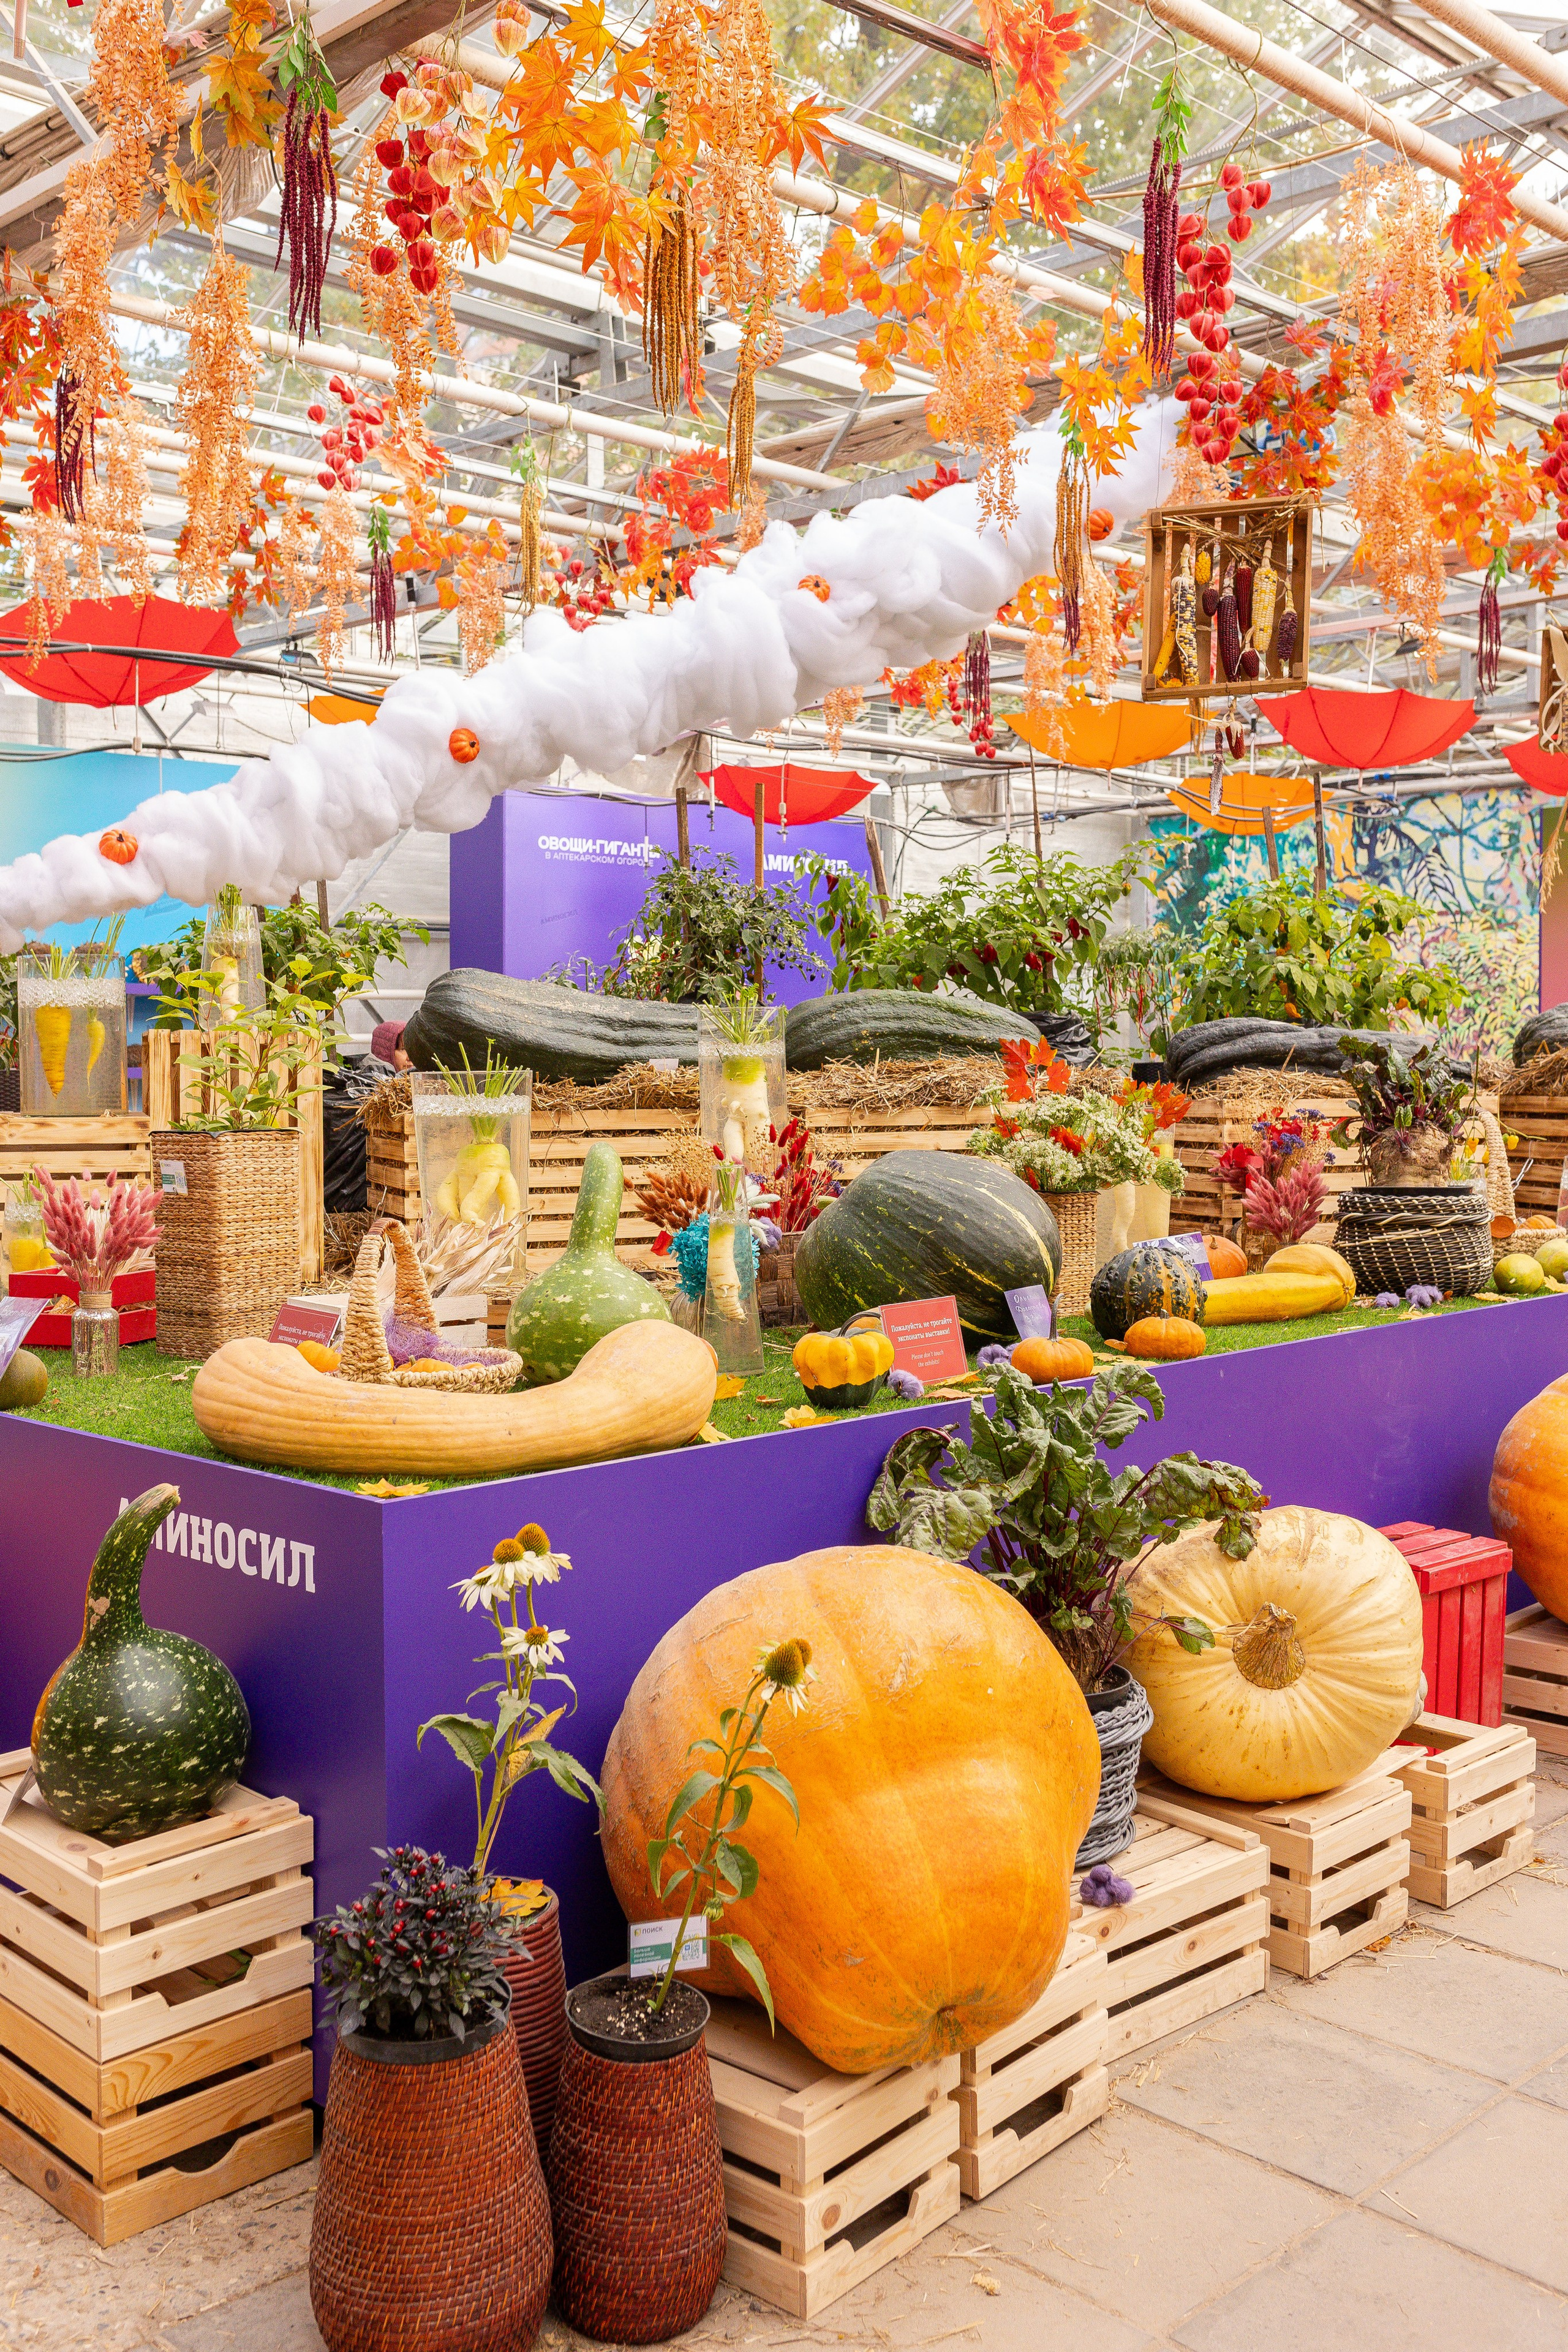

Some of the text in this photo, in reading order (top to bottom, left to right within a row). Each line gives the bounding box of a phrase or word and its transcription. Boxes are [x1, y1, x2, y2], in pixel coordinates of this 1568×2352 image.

[553, 853, 614, 864] АПТЕКАРСКОМ
[278, 1324, 301, 1335] Пожалуйста,
[308, 1330, 326, 1339] трогайте
[891, 1322, 923, 1332] Пожалуйста,
[930, 1317, 952, 1327] трогайте
[897, 1327, 950, 1342] экспонаты выставки!
